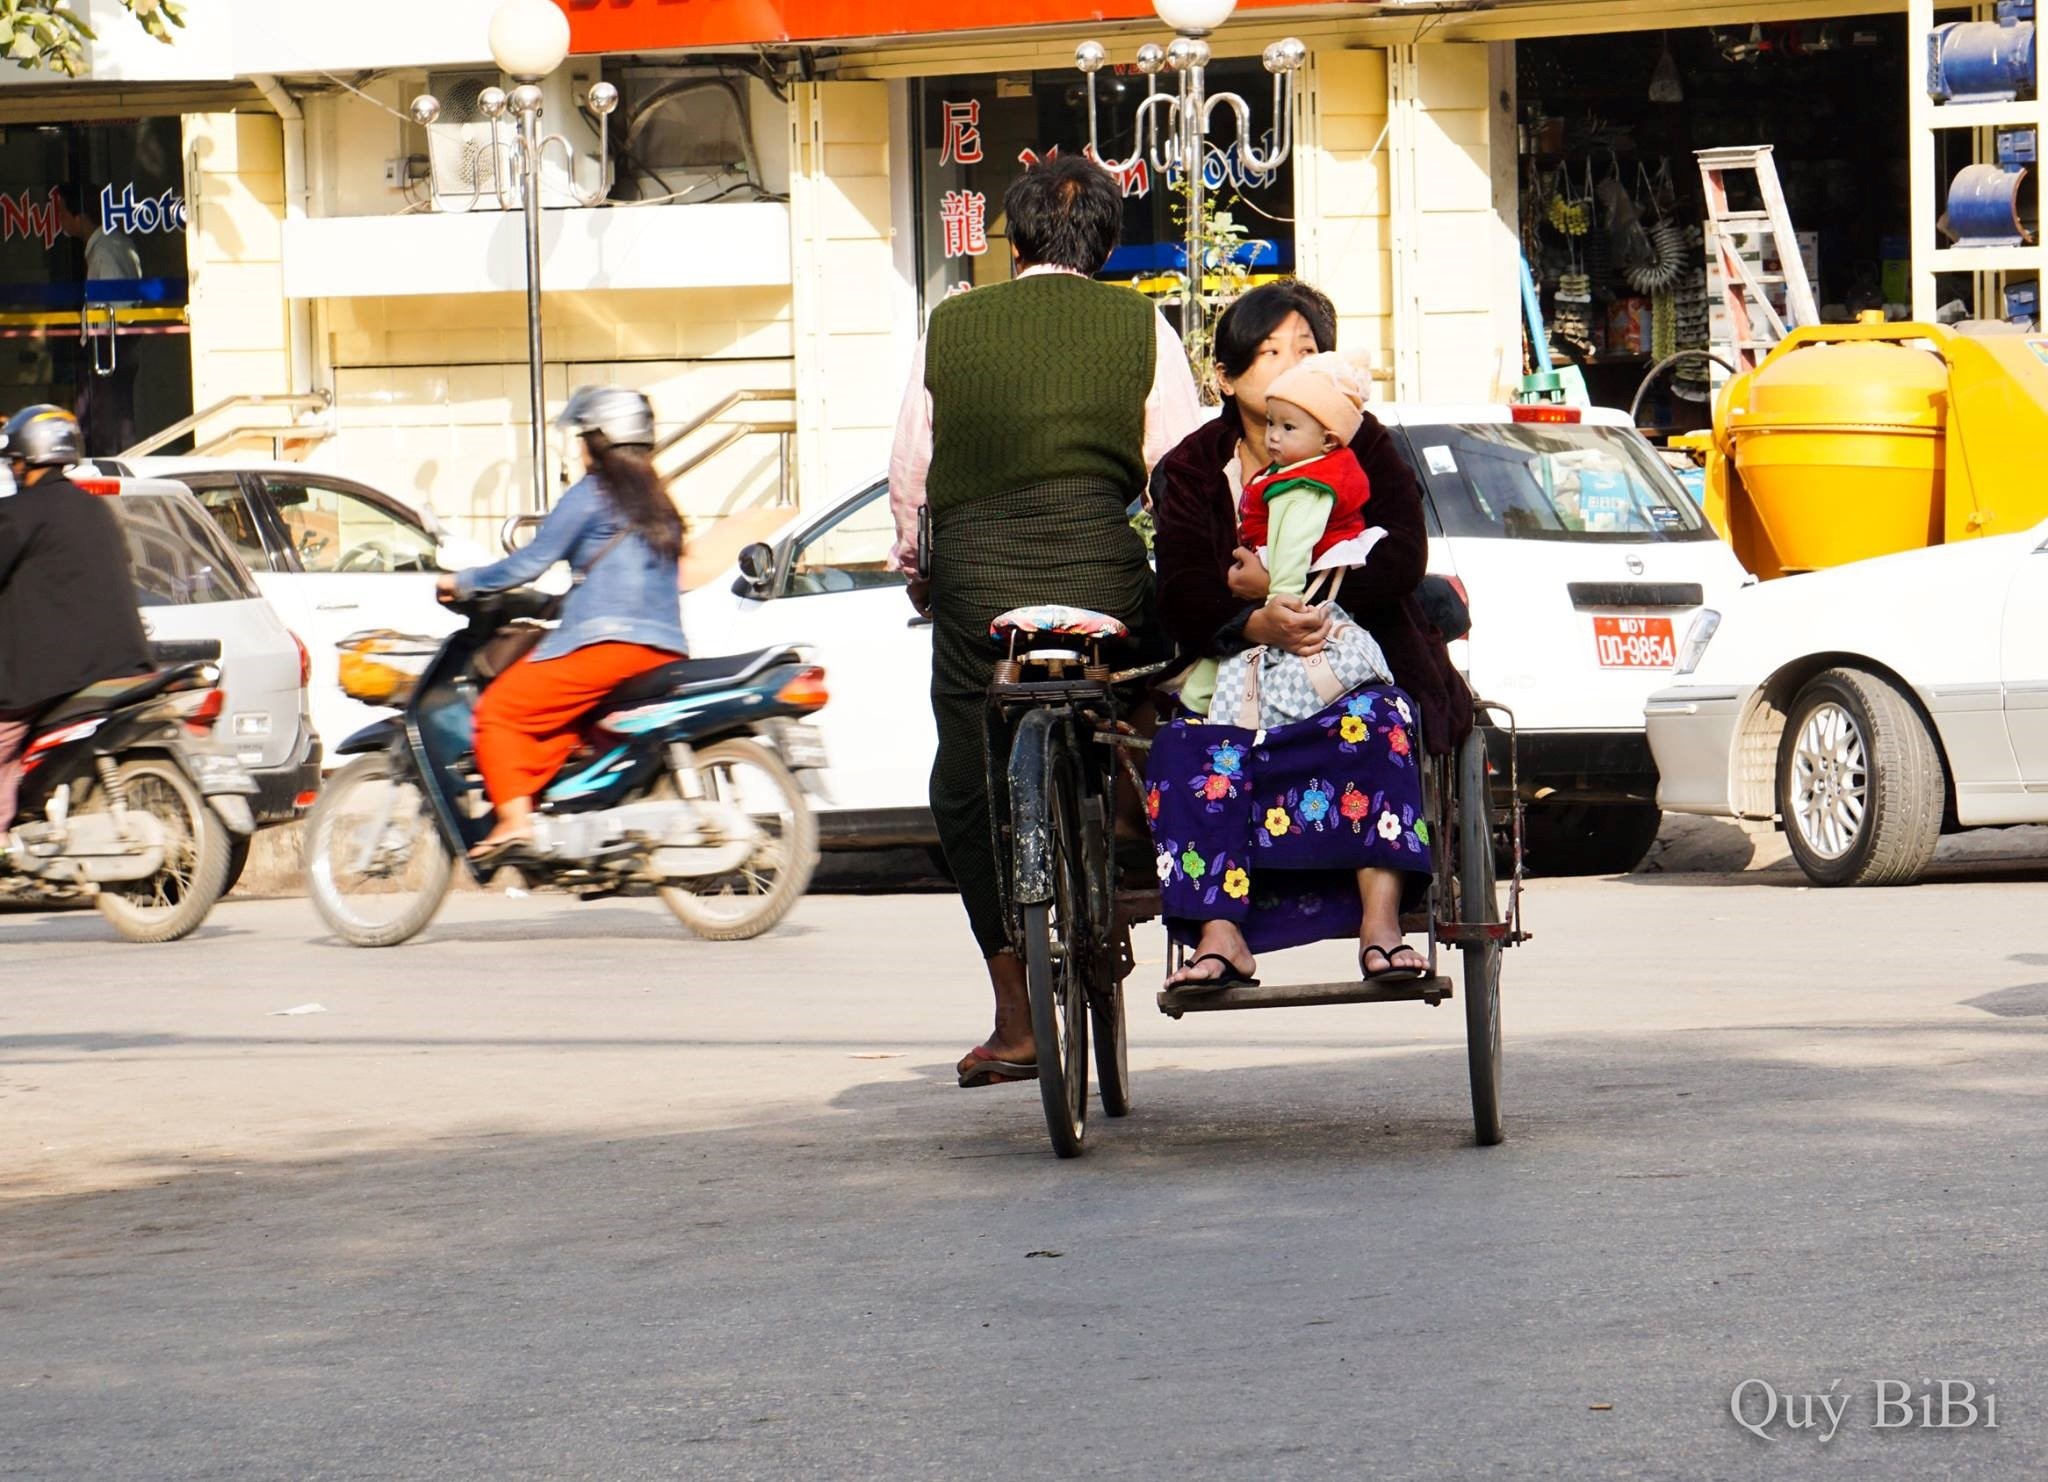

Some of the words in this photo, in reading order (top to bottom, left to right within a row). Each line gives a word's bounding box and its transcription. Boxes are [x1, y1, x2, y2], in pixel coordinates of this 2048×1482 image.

[0, 184, 66, 250] Nyl
[100, 182, 188, 235] Hote
[939, 98, 988, 298] 尼龍
[1598, 635, 1675, 666] DD-9854
